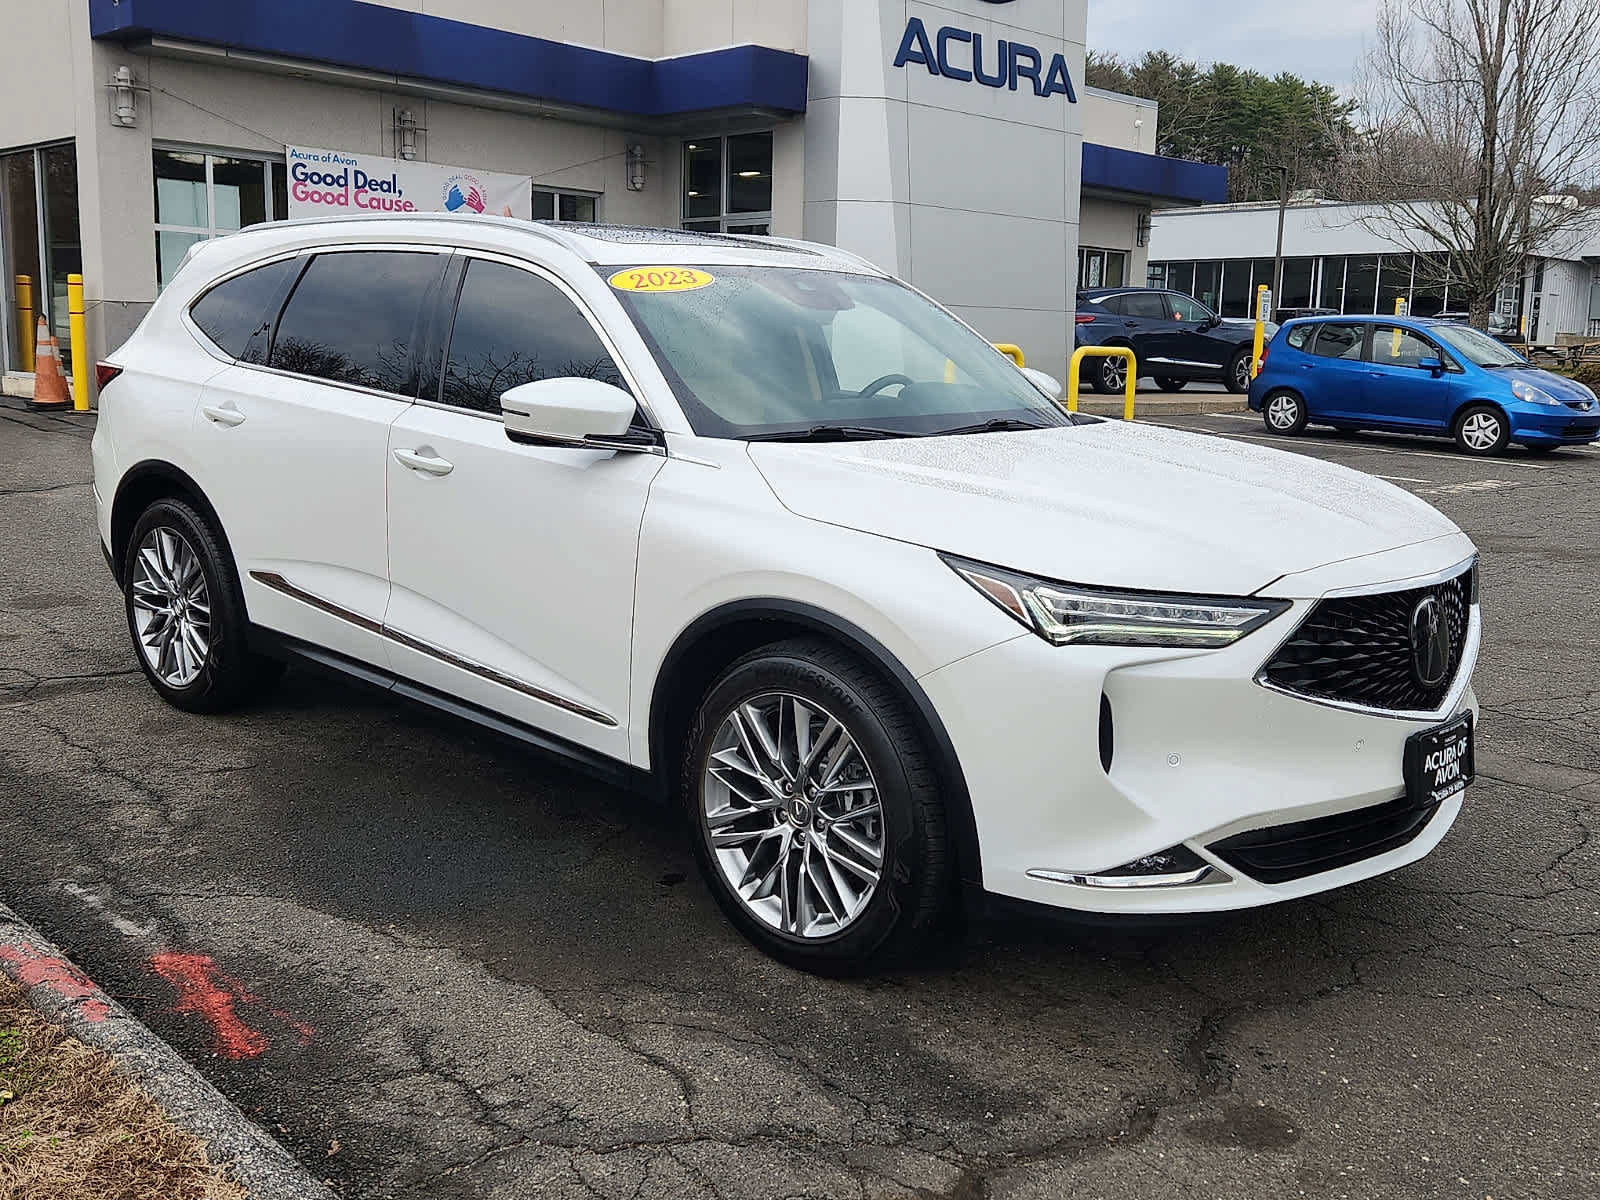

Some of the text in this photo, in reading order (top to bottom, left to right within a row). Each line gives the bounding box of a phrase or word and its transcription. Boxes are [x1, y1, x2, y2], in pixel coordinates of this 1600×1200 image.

[893, 17, 1077, 104] ACURA
[290, 148, 357, 166] Acura of Avon
[291, 162, 403, 198] Good Deal,
[291, 181, 419, 212] Good Cause.
[629, 270, 697, 289] 2023
[756, 663, 863, 713] IDGESTONE
[1424, 744, 1457, 774] ACURA
[1458, 737, 1468, 757] OF
[1434, 758, 1460, 787] AVON
